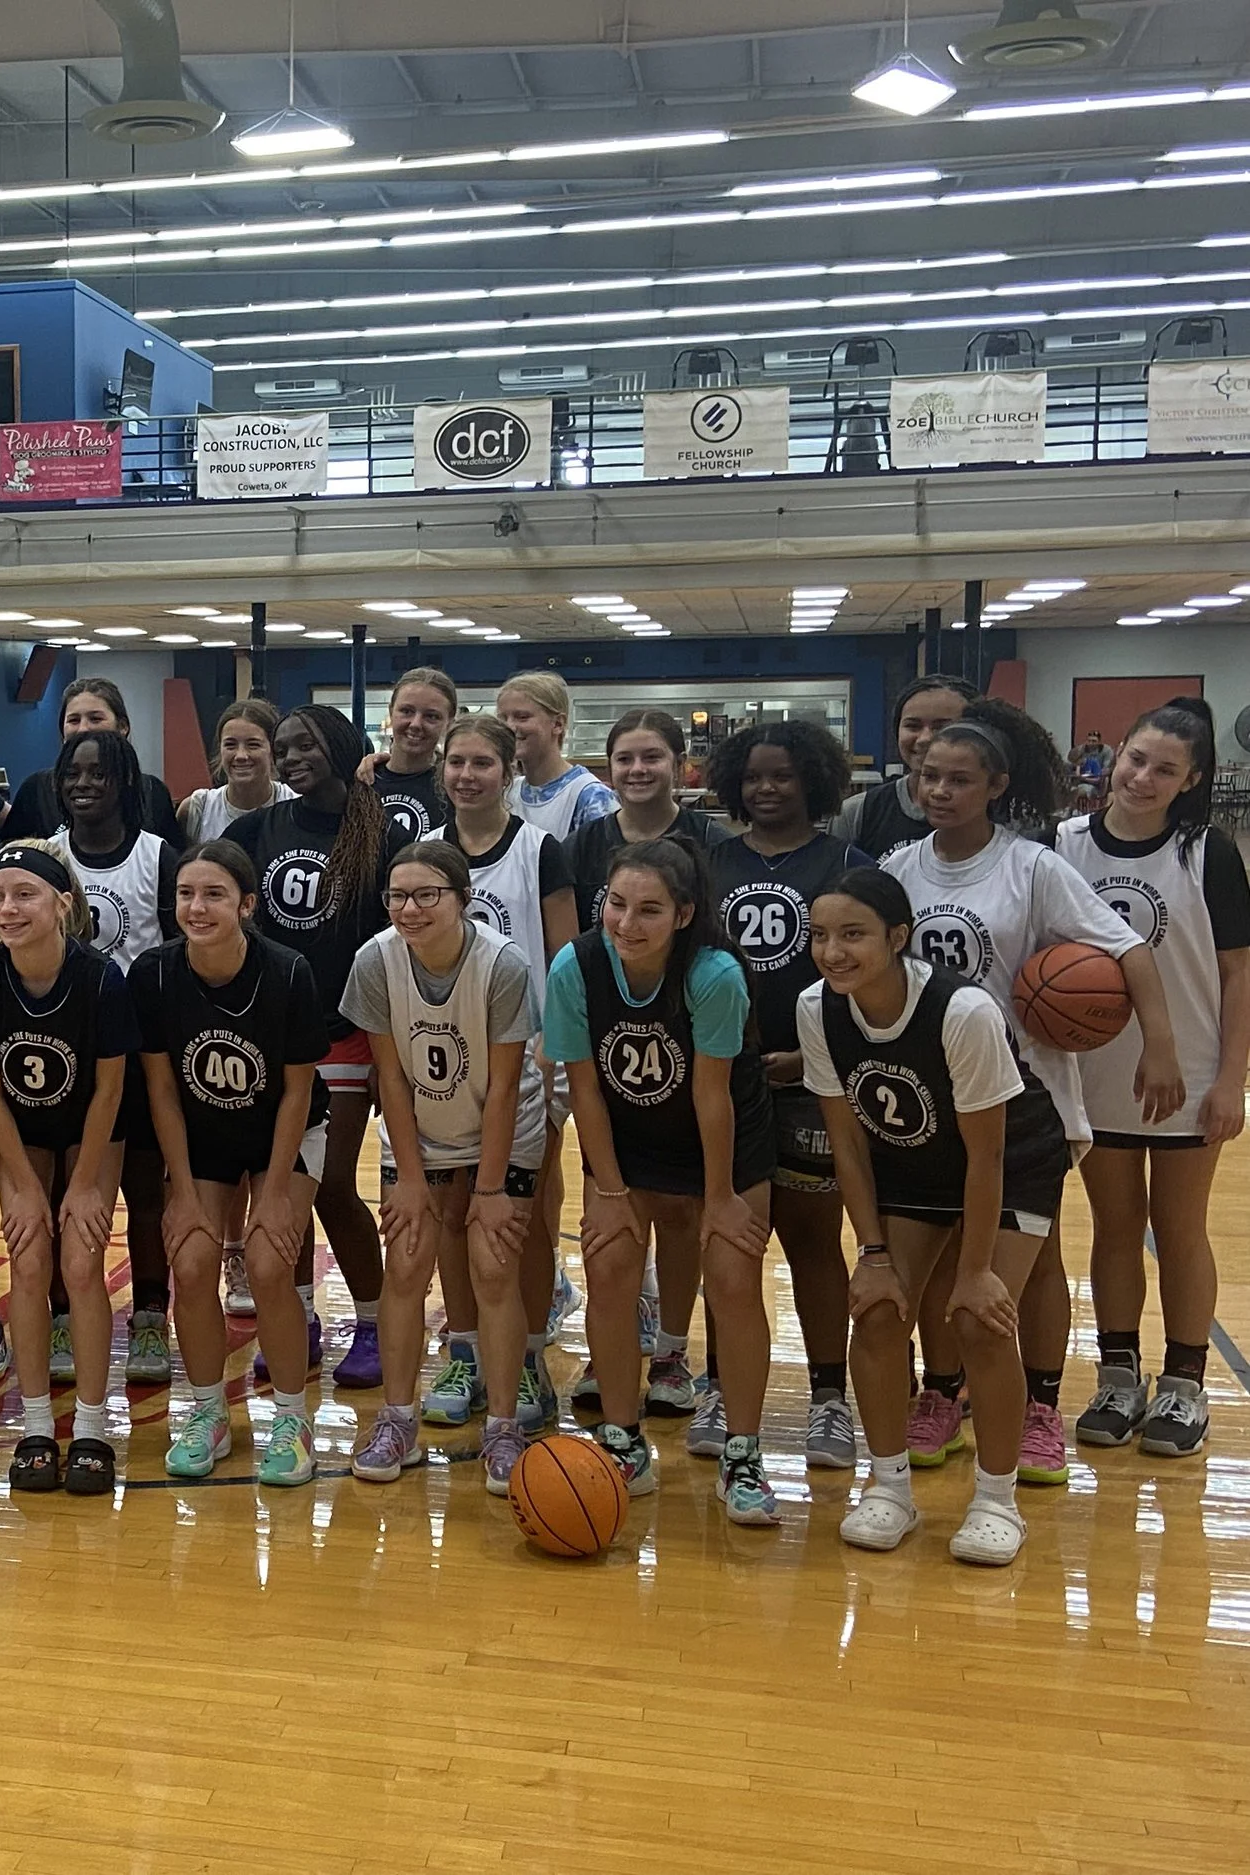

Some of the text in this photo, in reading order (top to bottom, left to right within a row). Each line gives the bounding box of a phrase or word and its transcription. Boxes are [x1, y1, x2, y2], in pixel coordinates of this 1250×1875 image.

[3, 425, 115, 450] Polished Paws
[235, 424, 289, 436] JACOBY
[452, 420, 513, 459] dcf
[897, 417, 927, 429] ZOE
[31, 450, 71, 458] GROOMING
[203, 437, 323, 452] CONSTRUCTION, LLC
[450, 457, 513, 466] www.dcfchurch.tv
[678, 448, 754, 460] FELLOWSHIP
[210, 460, 316, 473] PROUD SUPPORTERS
[692, 460, 741, 470] CHURCH
[238, 482, 272, 491] Coweta,
[386, 794, 402, 802] PUTS
[284, 849, 326, 861] SHE PUTS IN
[262, 858, 319, 930] SHE PUTS SKILLS CAMP
[283, 868, 320, 908] 61
[1092, 876, 1168, 926] SHE PUTS IN WORK SKILLS
[102, 886, 109, 894] IN
[109, 890, 126, 907] WORK
[121, 907, 130, 929] SKILLS
[477, 889, 511, 935] IN WORK SKILLS
[734, 882, 810, 953] SHE PUTS IN WORK SKILLS CAMP
[738, 903, 786, 946] 26
[916, 904, 993, 955] SHE PUTS IN WORK SKILLS
[768, 954, 791, 970] CAMP
[921, 929, 968, 972] 63
[25, 1032, 72, 1054] PUTS IN WORK
[213, 1029, 242, 1045] PUTS IN
[457, 1036, 469, 1059] SKILLS
[24, 1055, 45, 1089] 3
[184, 1041, 208, 1101] SHE WORK
[205, 1051, 247, 1091] 40
[428, 1045, 447, 1081] 9
[602, 1031, 673, 1105] SHE CAMP
[622, 1040, 663, 1084] 24
[418, 1088, 443, 1101] SKILLS
[859, 1059, 935, 1110] SHE IN WORK SKILLS
[847, 1070, 879, 1135] SHE IN WORK
[876, 1086, 905, 1126] 2
